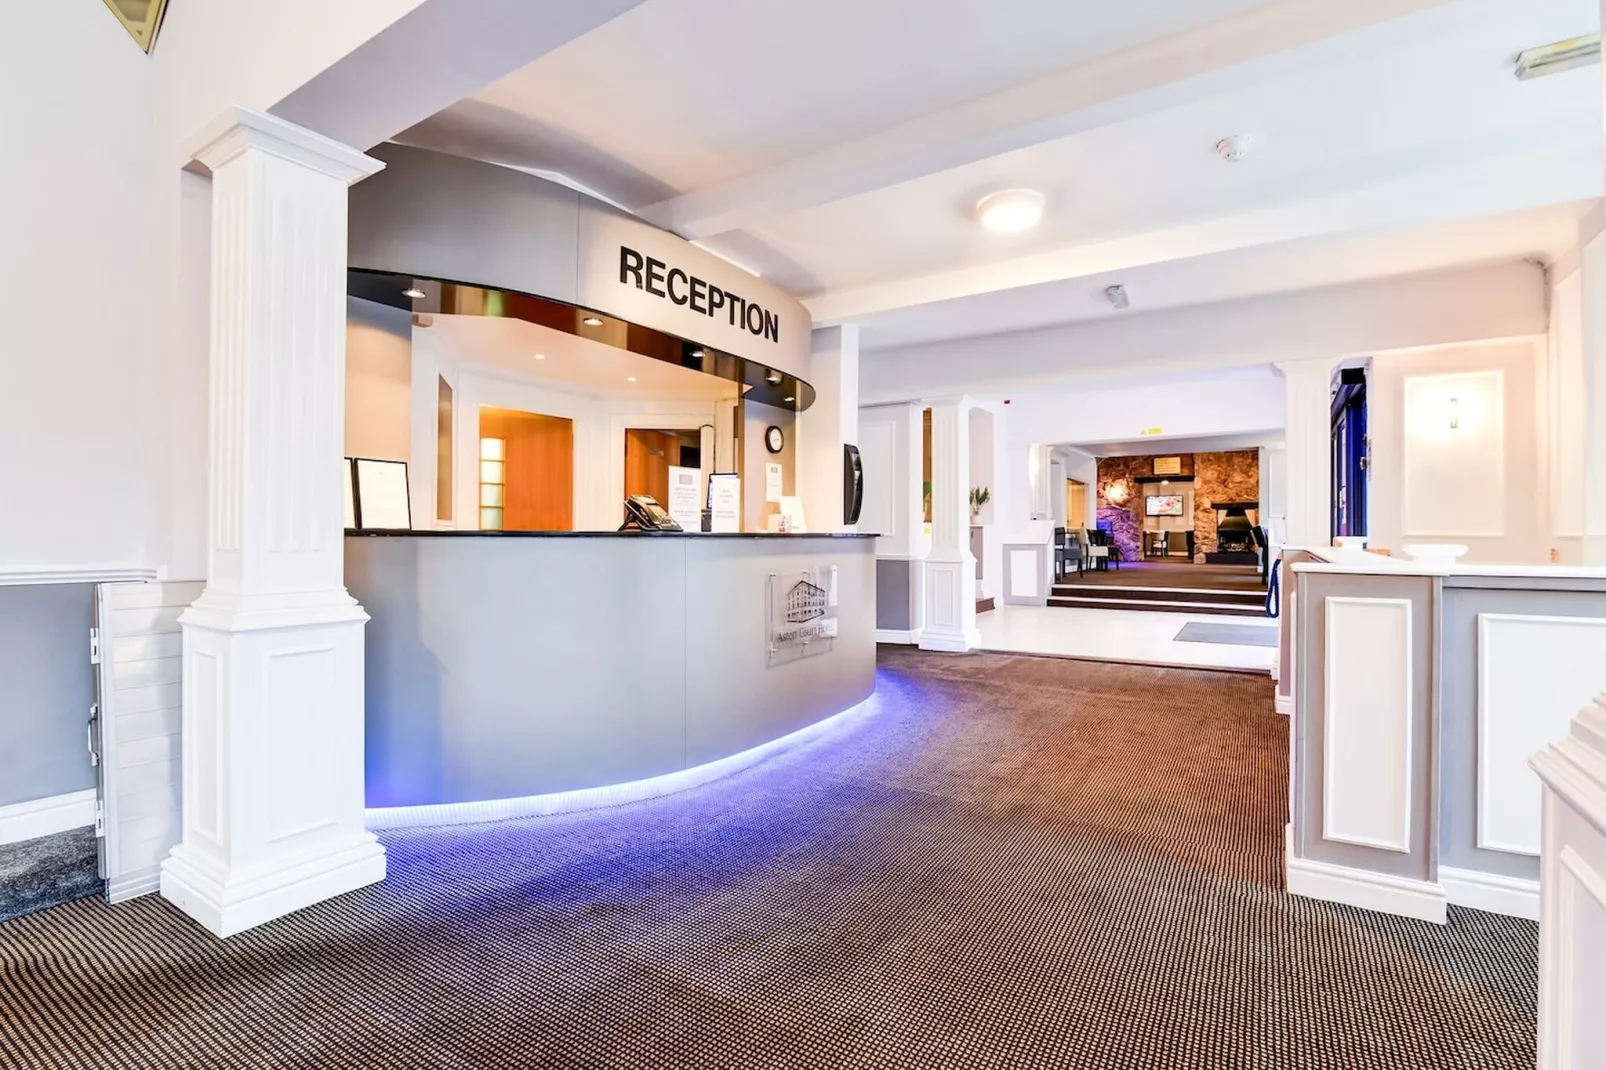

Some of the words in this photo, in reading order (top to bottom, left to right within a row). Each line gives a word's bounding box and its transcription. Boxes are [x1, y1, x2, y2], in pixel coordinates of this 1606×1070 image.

[620, 246, 778, 343] RECEPTION
[777, 630, 798, 642] Aston
[799, 626, 817, 638] Court
